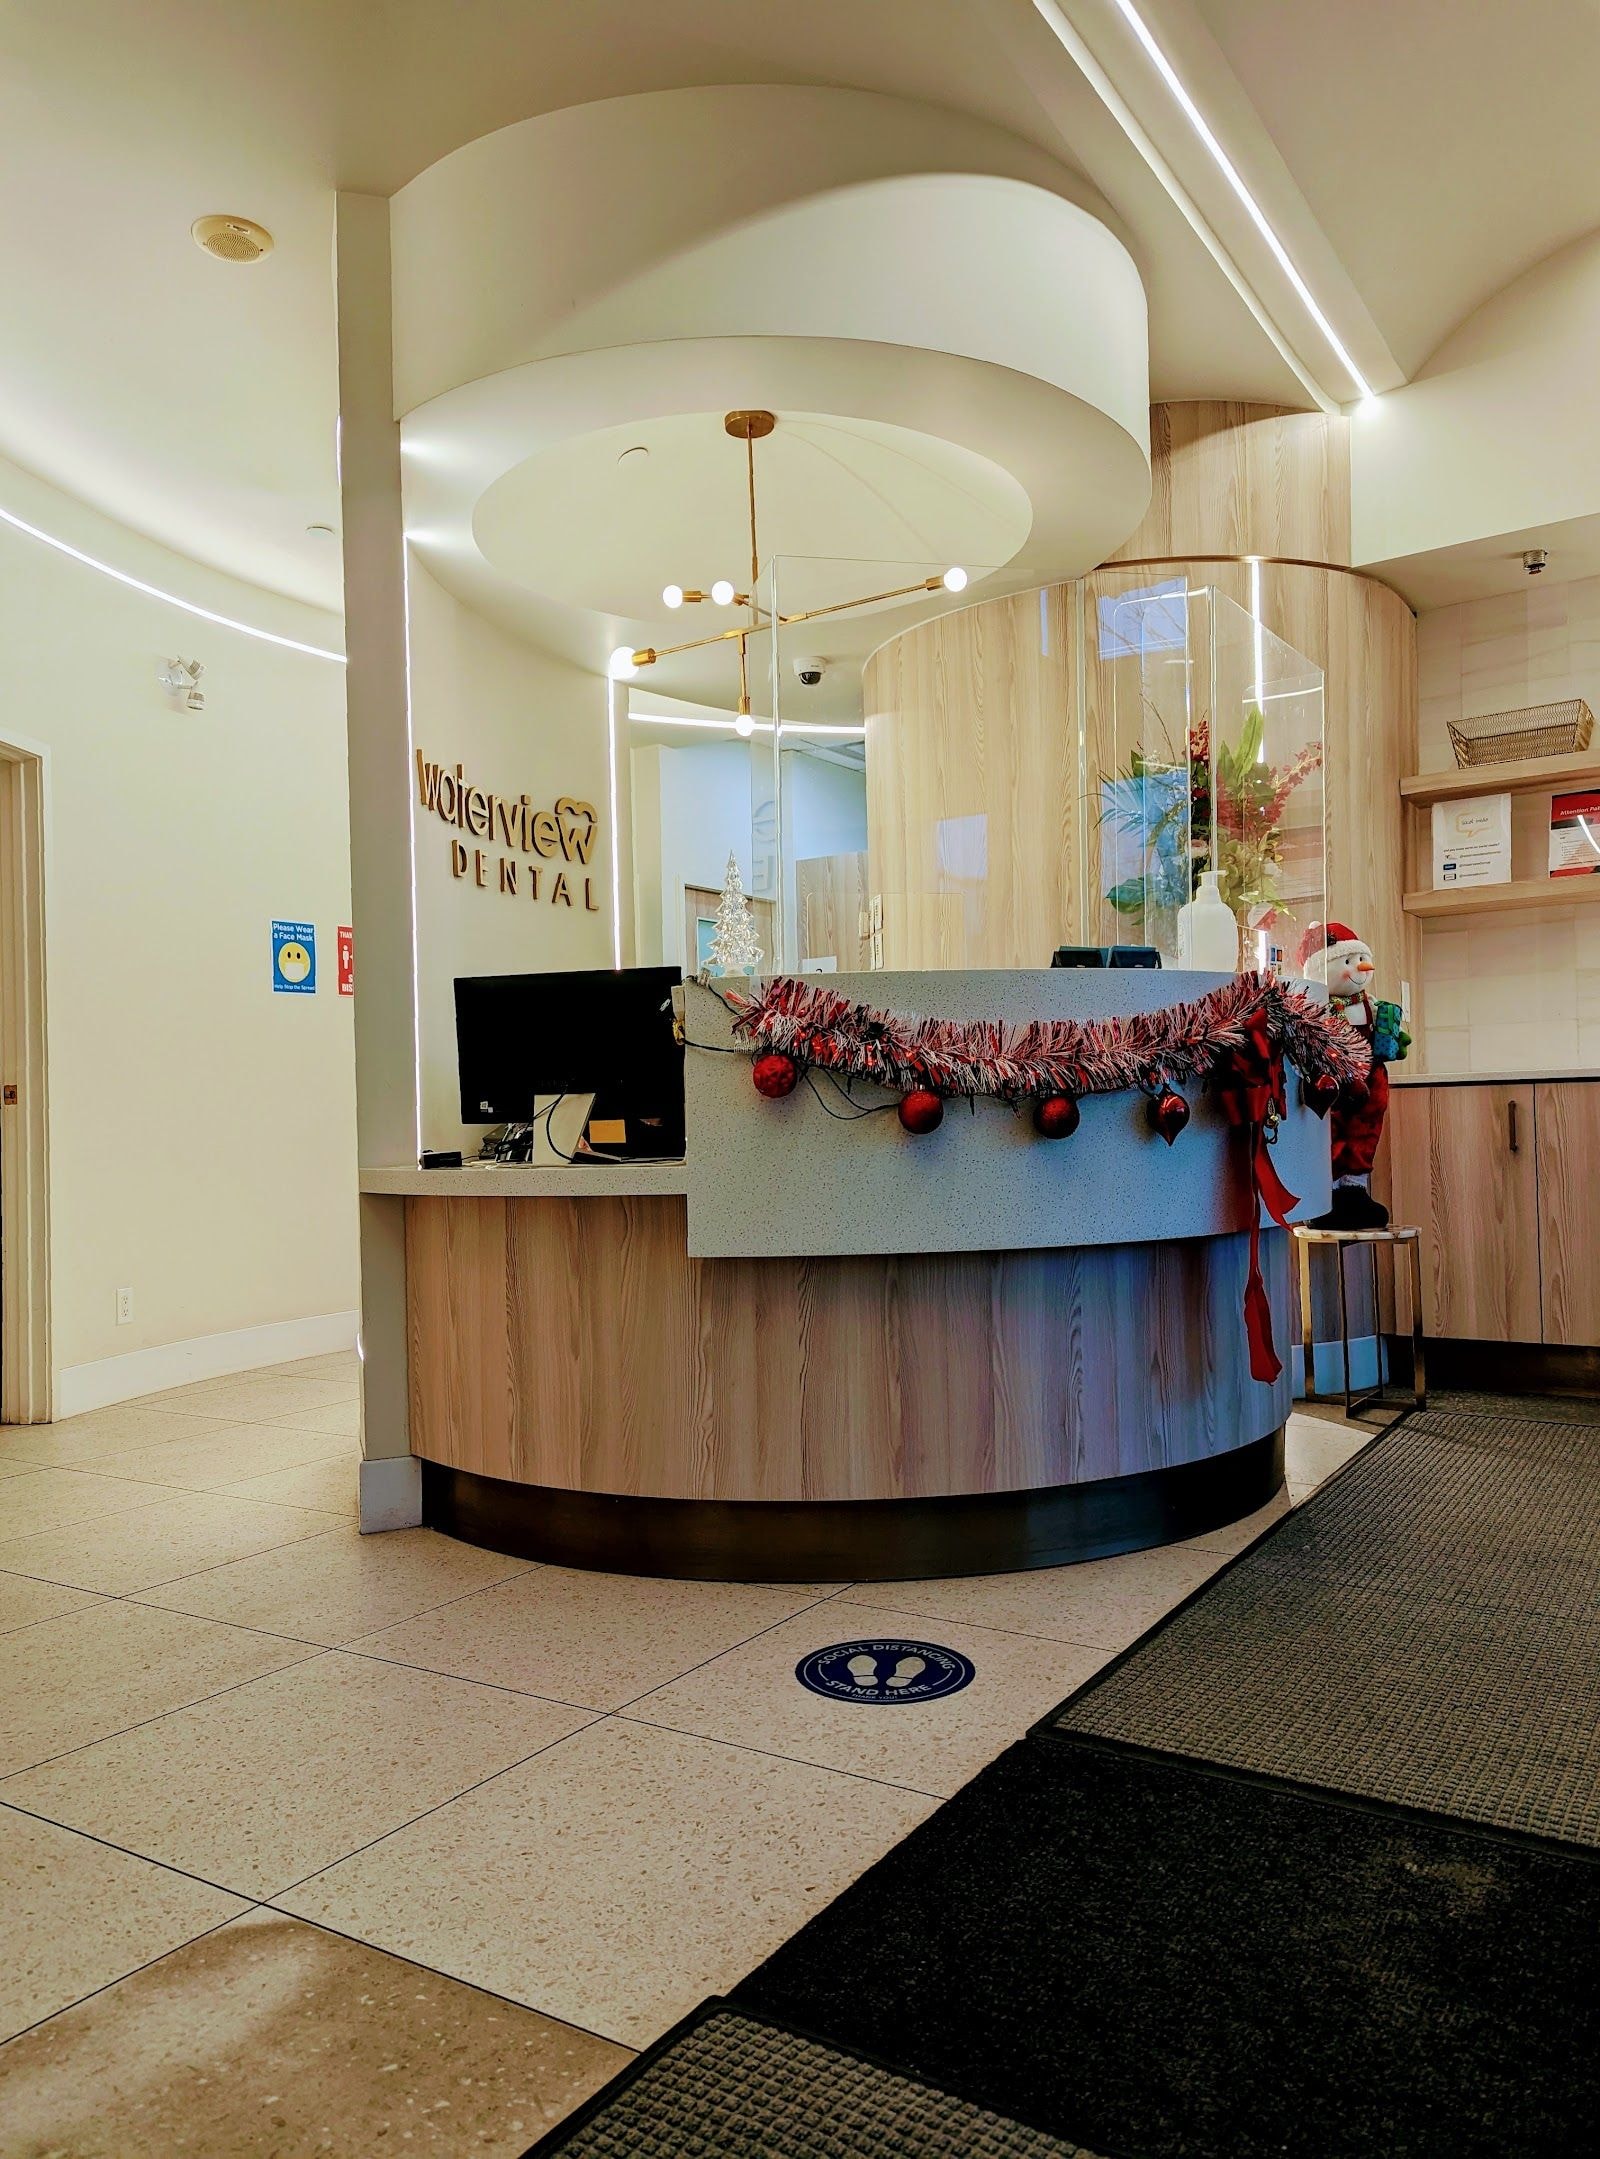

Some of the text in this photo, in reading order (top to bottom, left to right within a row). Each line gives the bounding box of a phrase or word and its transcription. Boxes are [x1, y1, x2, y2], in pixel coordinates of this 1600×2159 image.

[416, 749, 598, 865] waterview
[1559, 807, 1589, 816] Attention
[452, 839, 599, 911] DENTAL
[273, 923, 314, 934] Please Wear
[279, 932, 295, 940] Face
[296, 934, 314, 942] Mask
[818, 1644, 956, 1670] SOCIAL DISTANCING
[826, 1680, 933, 1696] STAND HERE
